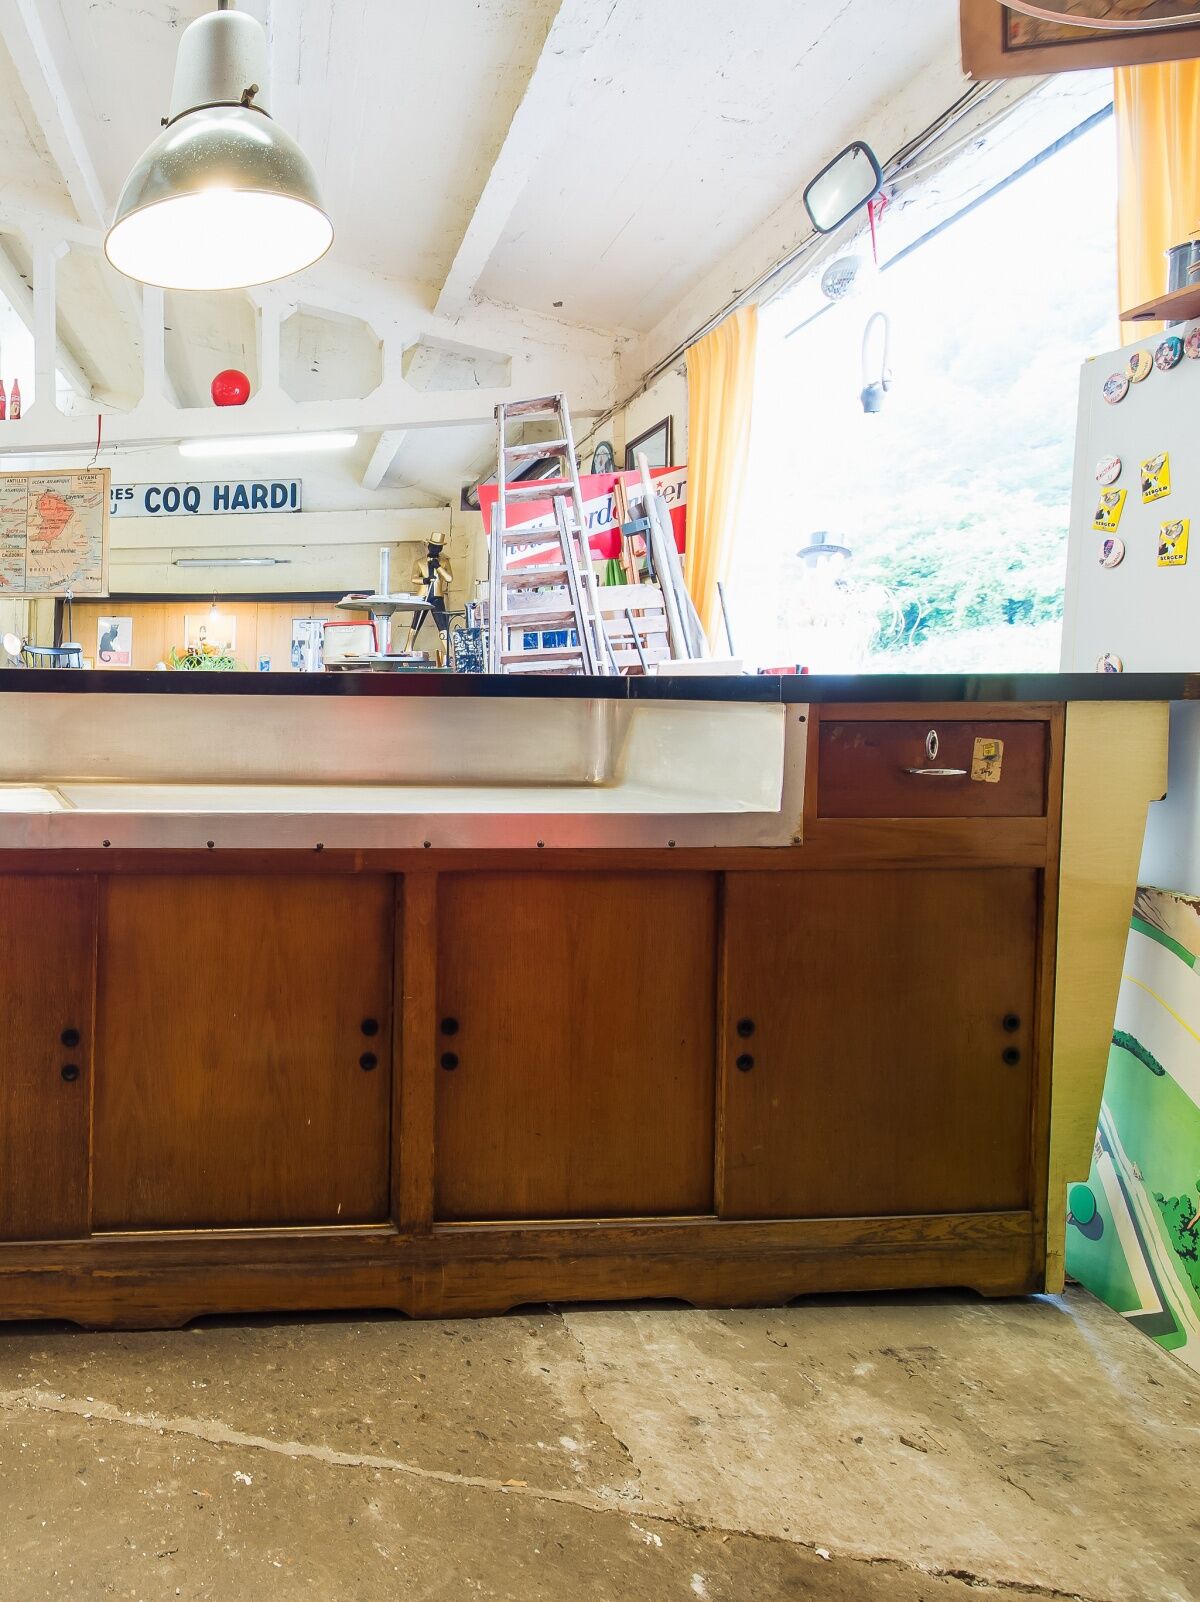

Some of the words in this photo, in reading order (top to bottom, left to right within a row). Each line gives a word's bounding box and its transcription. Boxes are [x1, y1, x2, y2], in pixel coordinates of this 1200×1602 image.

[1145, 485, 1168, 497] BERGER
[144, 486, 201, 514] COQ
[213, 482, 297, 510] HARDI
[1095, 520, 1116, 528] BERGER
